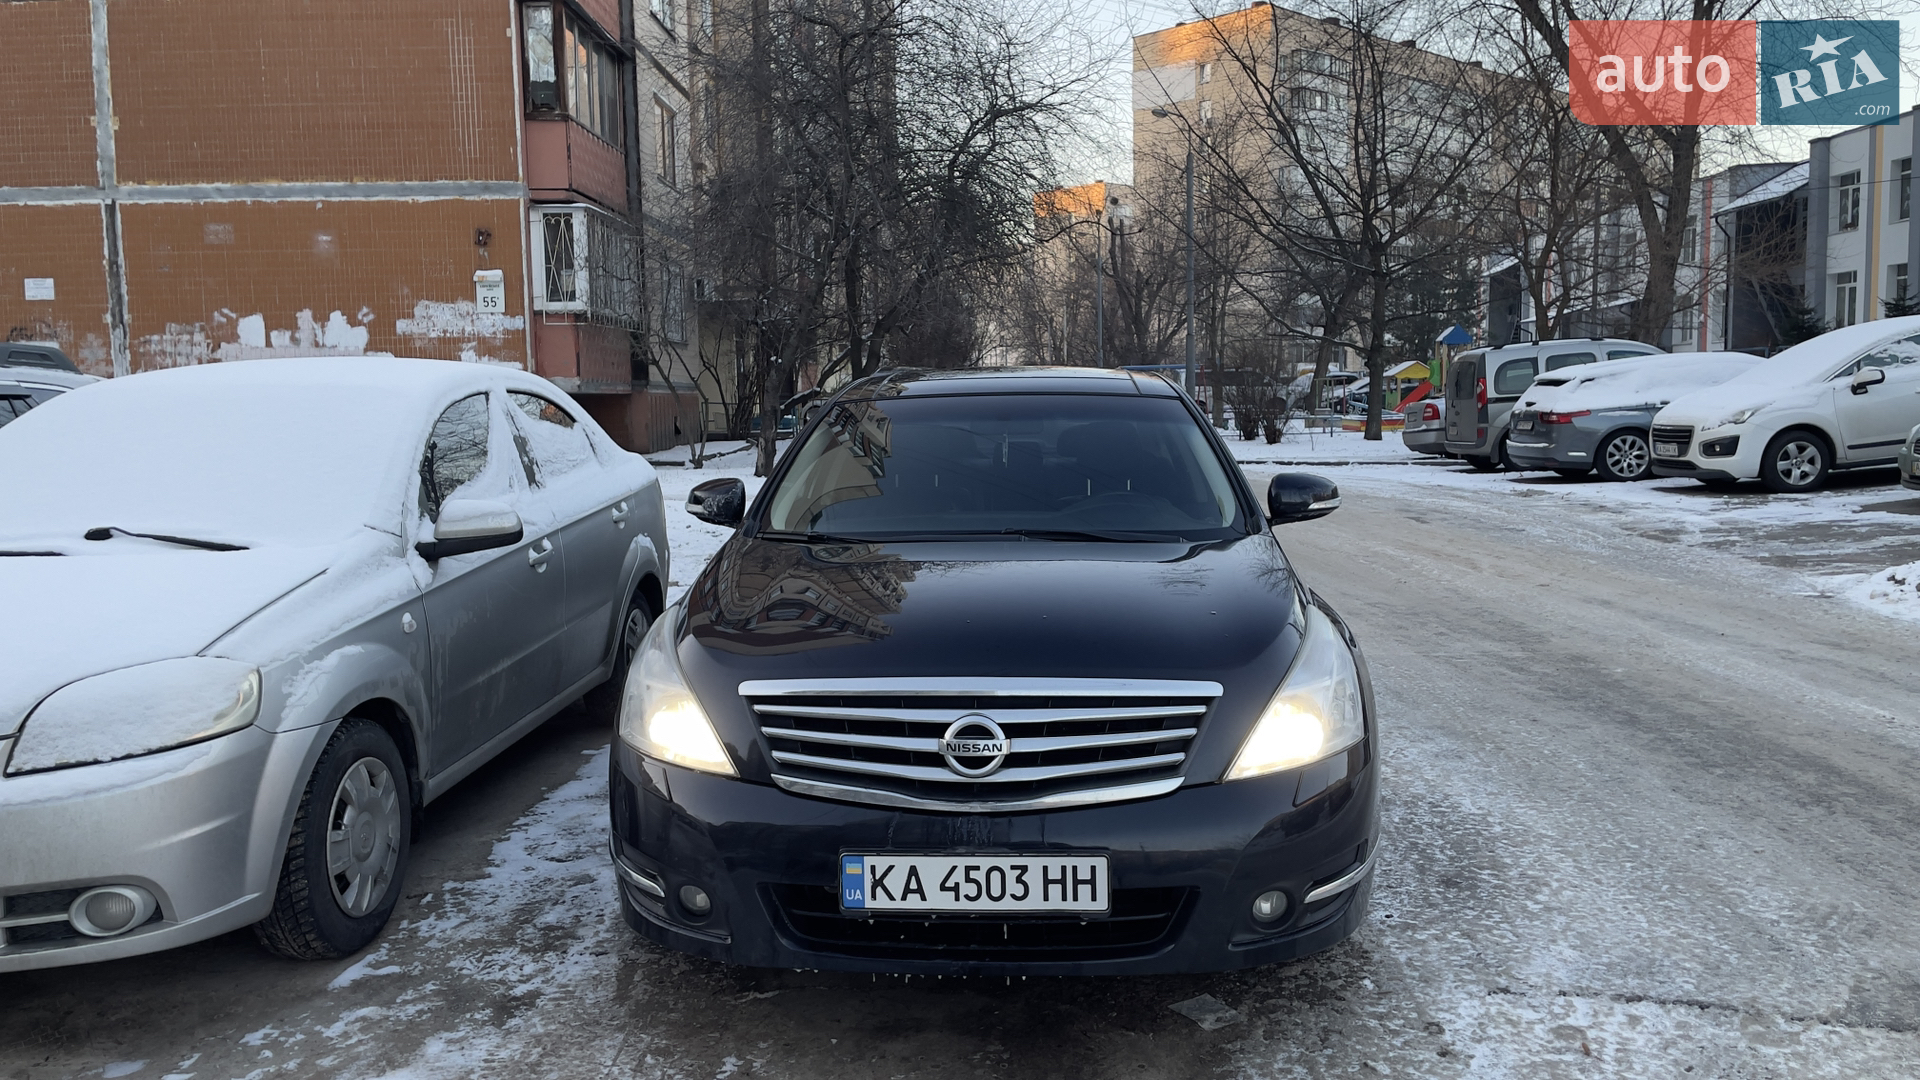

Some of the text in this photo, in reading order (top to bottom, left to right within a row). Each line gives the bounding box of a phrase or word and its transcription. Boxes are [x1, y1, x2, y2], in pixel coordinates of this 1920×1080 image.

[946, 743, 1002, 753] NISSAN
[870, 864, 1097, 902] KA 4503 HH
[846, 889, 863, 900] UA
